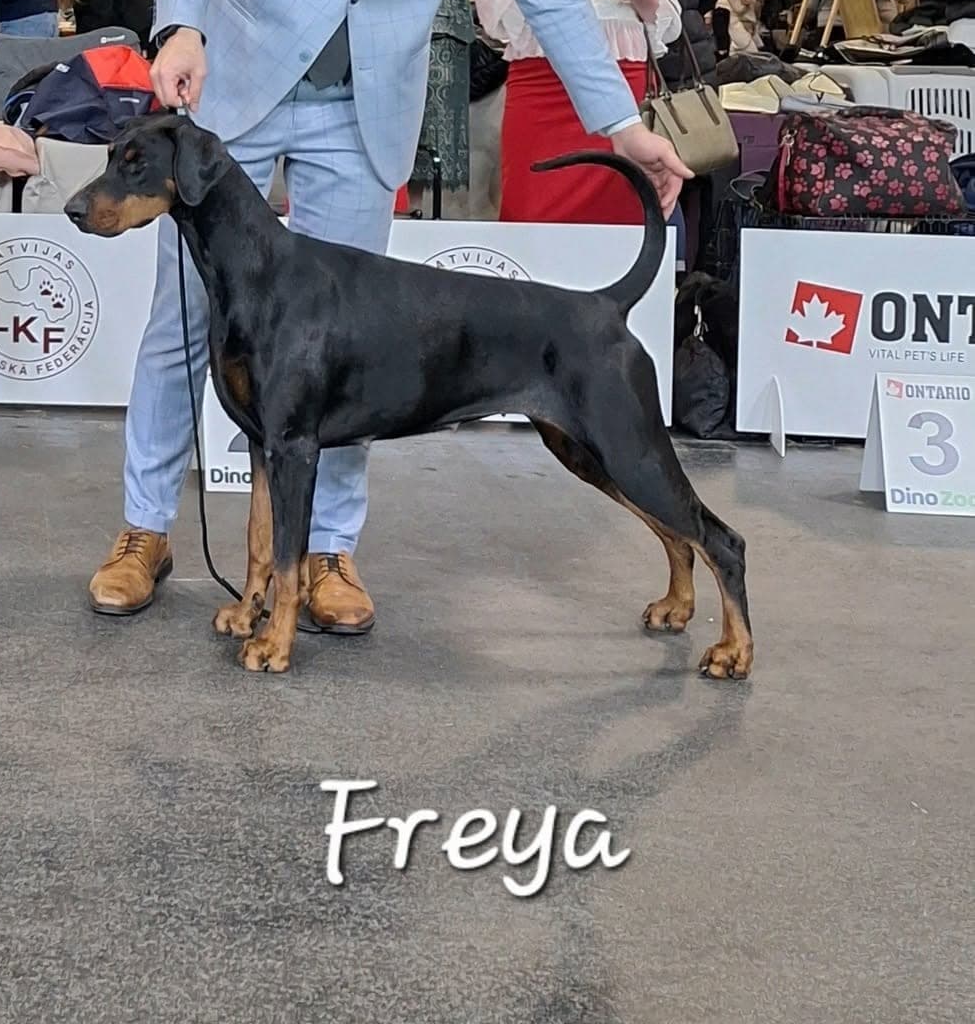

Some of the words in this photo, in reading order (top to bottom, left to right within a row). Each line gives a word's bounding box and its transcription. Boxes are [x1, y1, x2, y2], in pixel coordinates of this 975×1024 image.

[435, 252, 520, 280] ATVIJAS
[868, 349, 900, 360] VITAL
[905, 350, 937, 361] PET'S
[940, 352, 965, 363] LIFE
[905, 384, 971, 401] ONTARIO
[907, 411, 960, 476] 3
